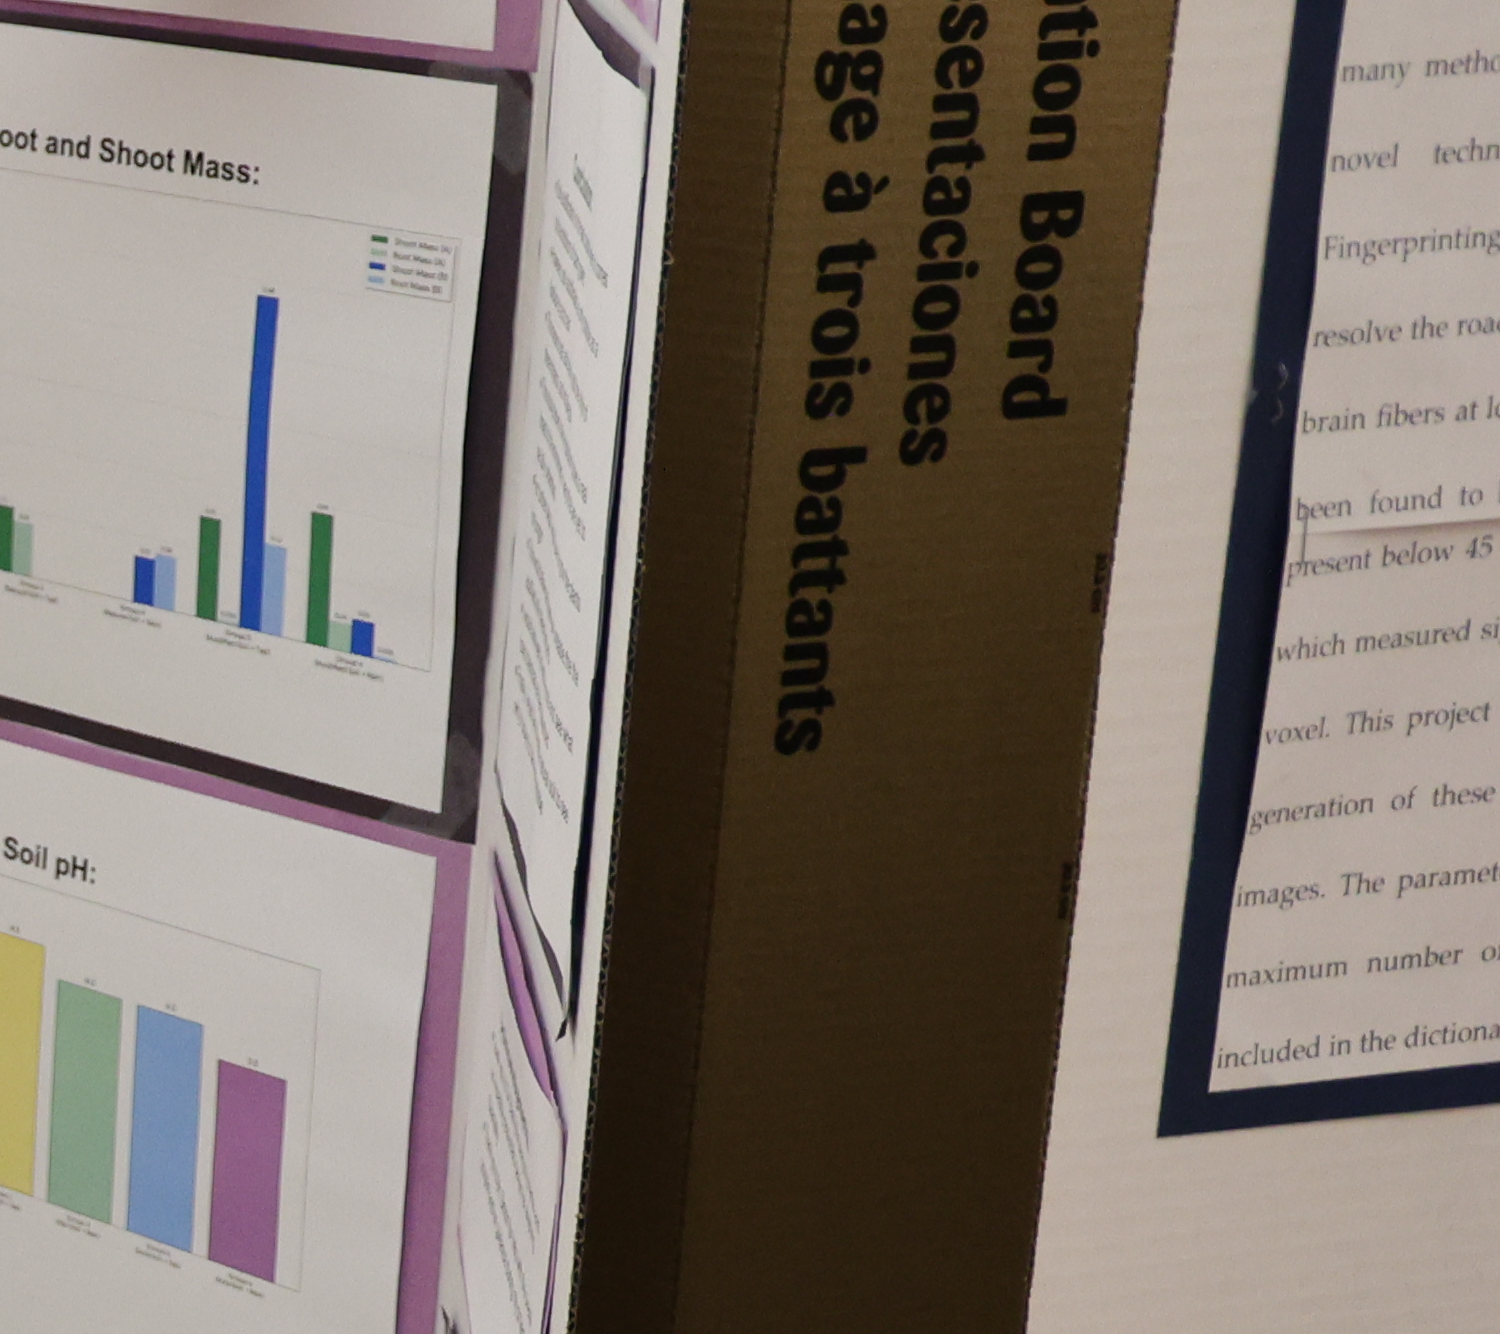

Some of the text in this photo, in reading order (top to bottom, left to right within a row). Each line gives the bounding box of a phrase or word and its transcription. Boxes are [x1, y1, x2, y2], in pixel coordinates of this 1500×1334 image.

[45, 135, 91, 159] and
[99, 137, 175, 173] Shoot
[183, 149, 259, 185] Mass:
[822, 170, 890, 214] à
[805, 238, 877, 420] trois
[1001, 190, 1085, 420] Board
[775, 446, 868, 755] battants
[1267, 702, 1491, 744] voxel. This project
[1248, 783, 1496, 834] generation of these
[3, 836, 95, 884] Soil pH:
[1228, 945, 1463, 987] maximum number
[1218, 1029, 1397, 1068] included in the
